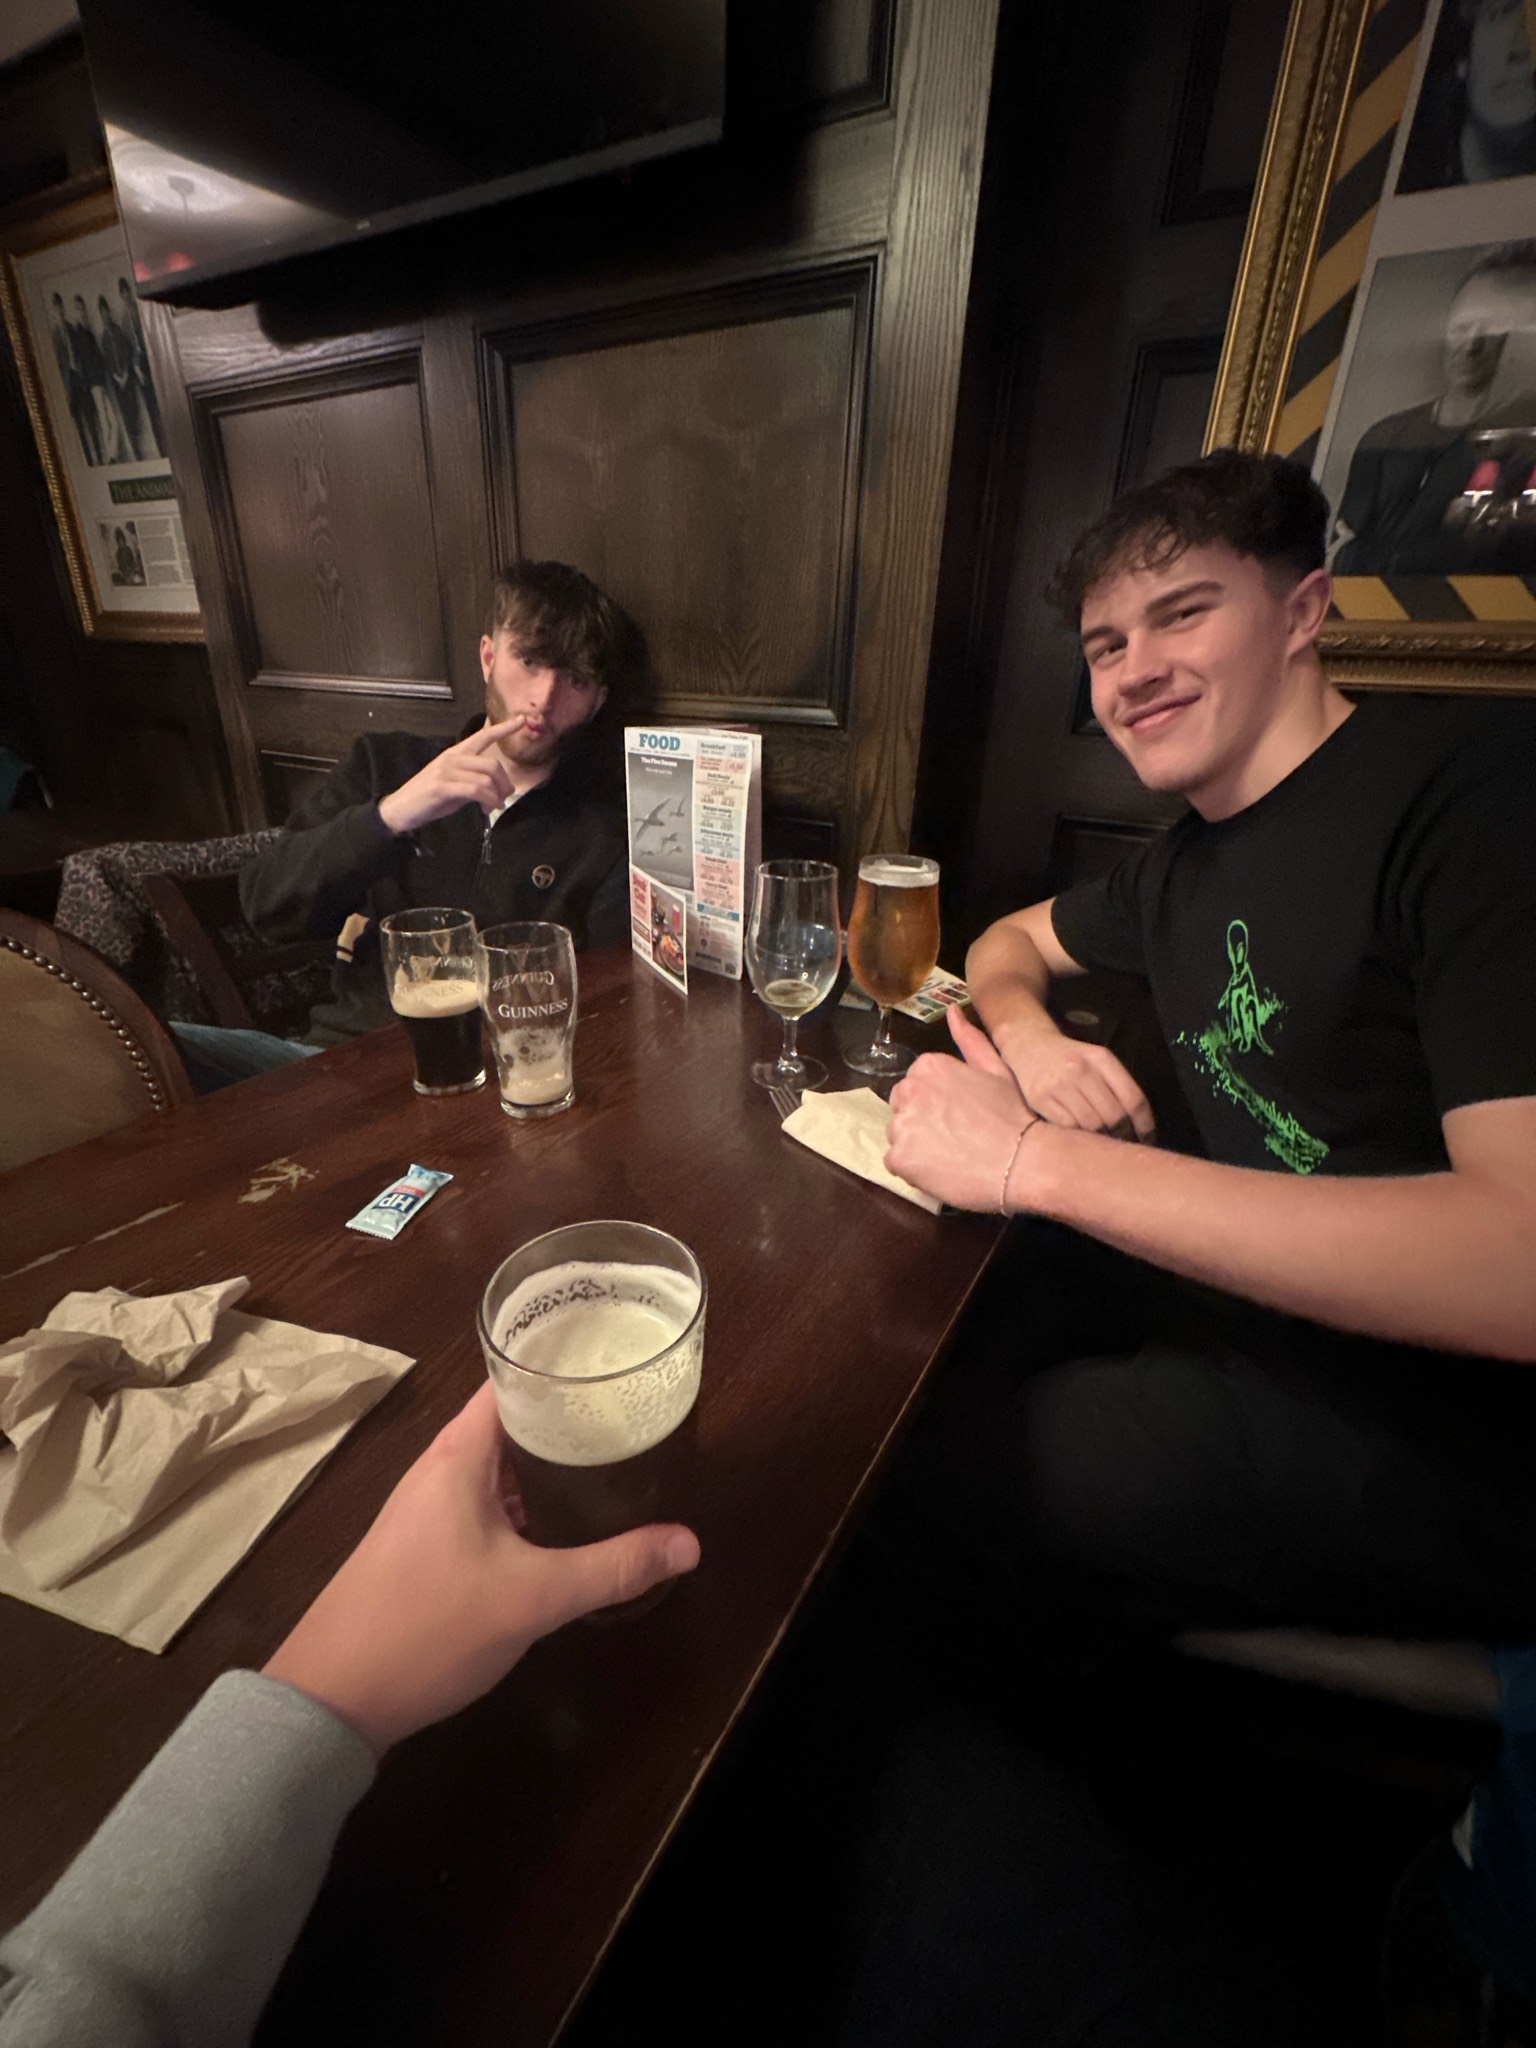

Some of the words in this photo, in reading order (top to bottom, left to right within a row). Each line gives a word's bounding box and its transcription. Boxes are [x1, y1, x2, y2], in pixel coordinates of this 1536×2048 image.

[639, 733, 681, 751] FOOD
[498, 998, 568, 1019] GUINNESS
[379, 1193, 415, 1212] HP
